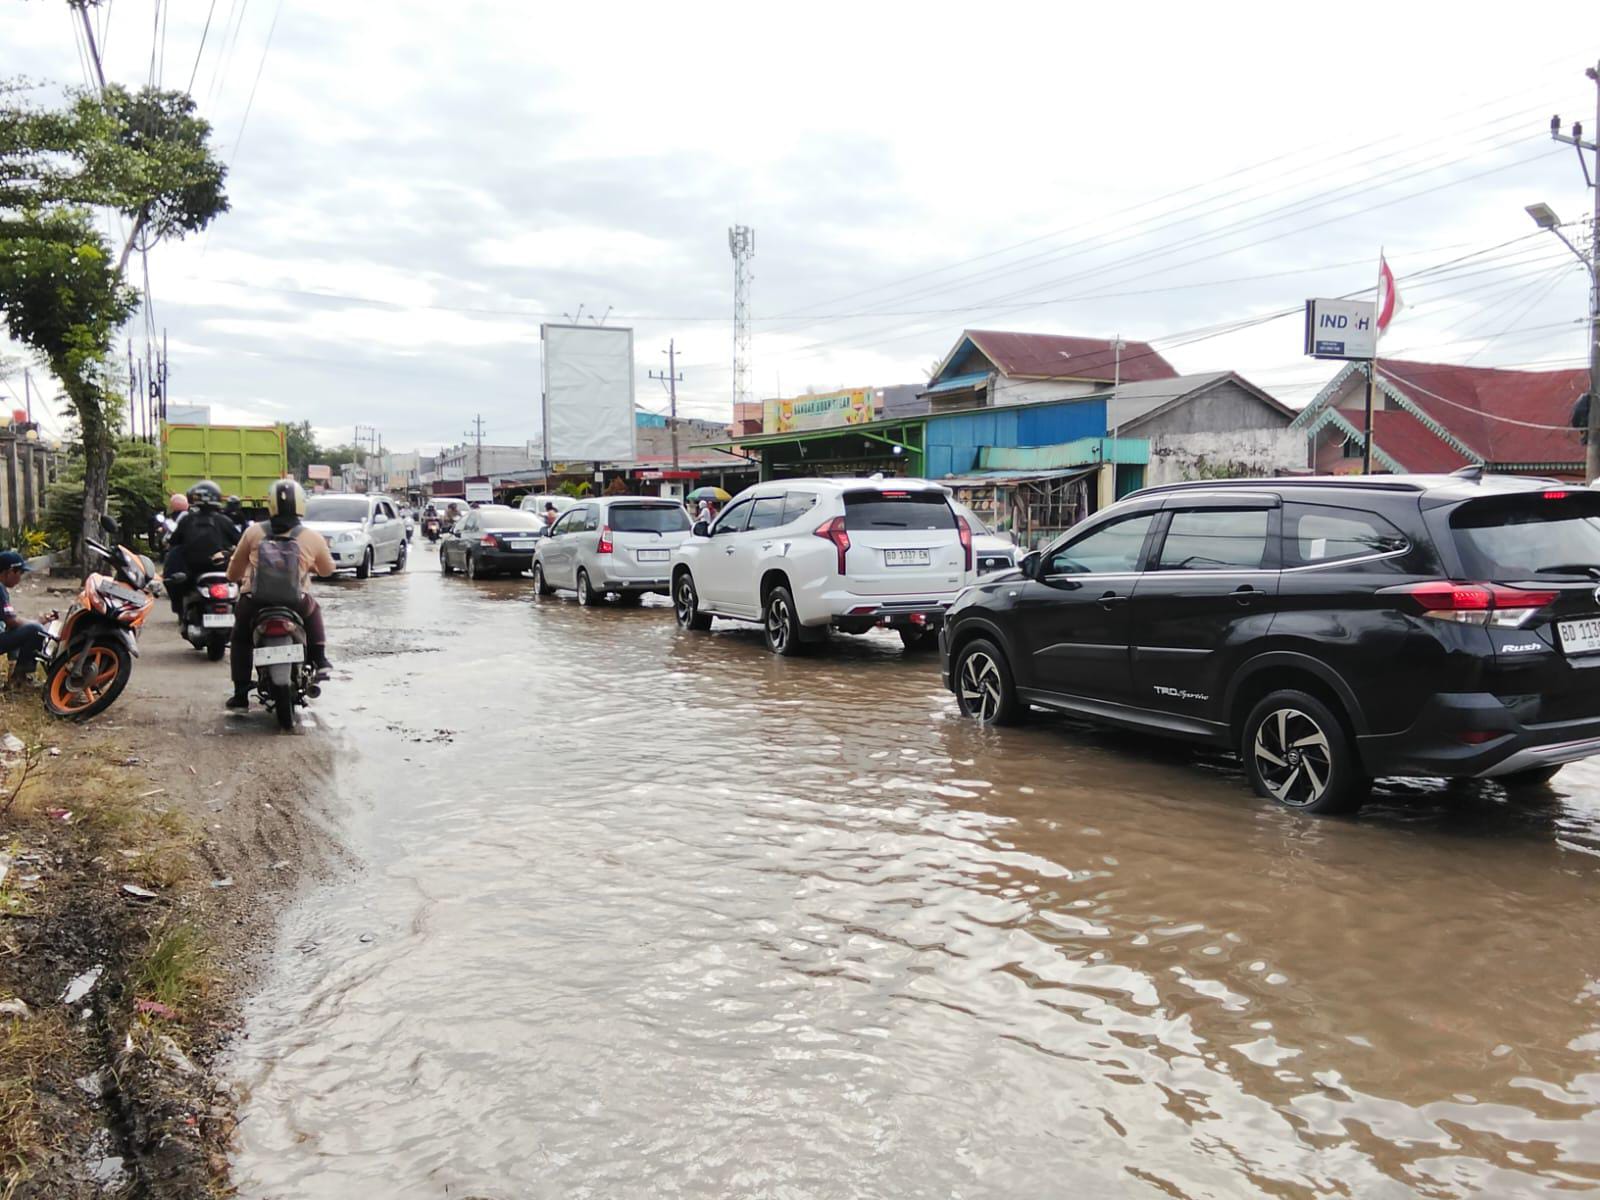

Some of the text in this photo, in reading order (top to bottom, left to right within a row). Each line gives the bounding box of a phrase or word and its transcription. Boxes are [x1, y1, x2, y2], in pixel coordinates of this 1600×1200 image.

[1320, 313, 1369, 330] INDH
[886, 551, 897, 560] BD
[1561, 620, 1600, 642] BD 113
[1502, 643, 1542, 653] Rush
[1153, 685, 1178, 696] TRD
